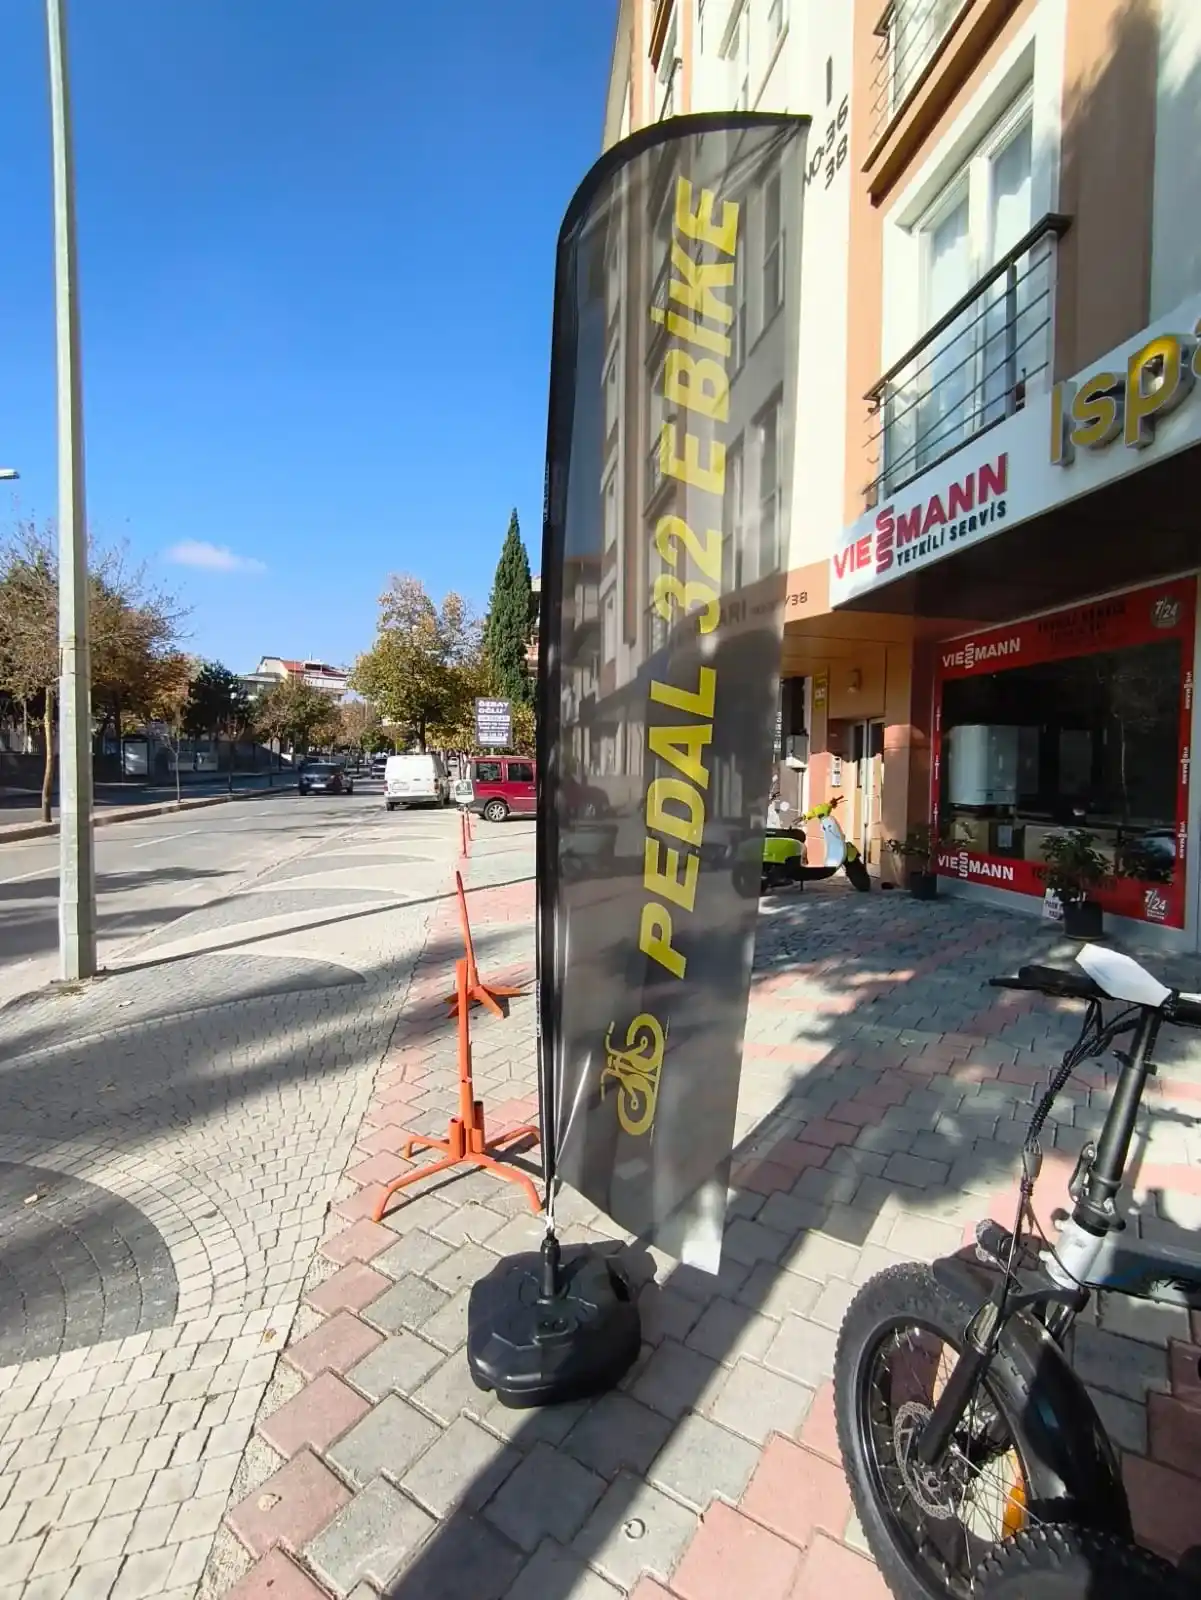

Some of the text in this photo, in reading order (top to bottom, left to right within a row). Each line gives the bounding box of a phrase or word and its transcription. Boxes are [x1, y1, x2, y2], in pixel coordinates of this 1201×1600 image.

[824, 134, 848, 190] 38
[833, 452, 1009, 579] VIESSMANN
[896, 499, 1007, 567] YETKİLİ SERVİS
[653, 513, 723, 635] 32
[942, 637, 1021, 670] VIESSMANN
[639, 665, 717, 979] PEDAL
[938, 851, 1014, 881] VIESSMANN
